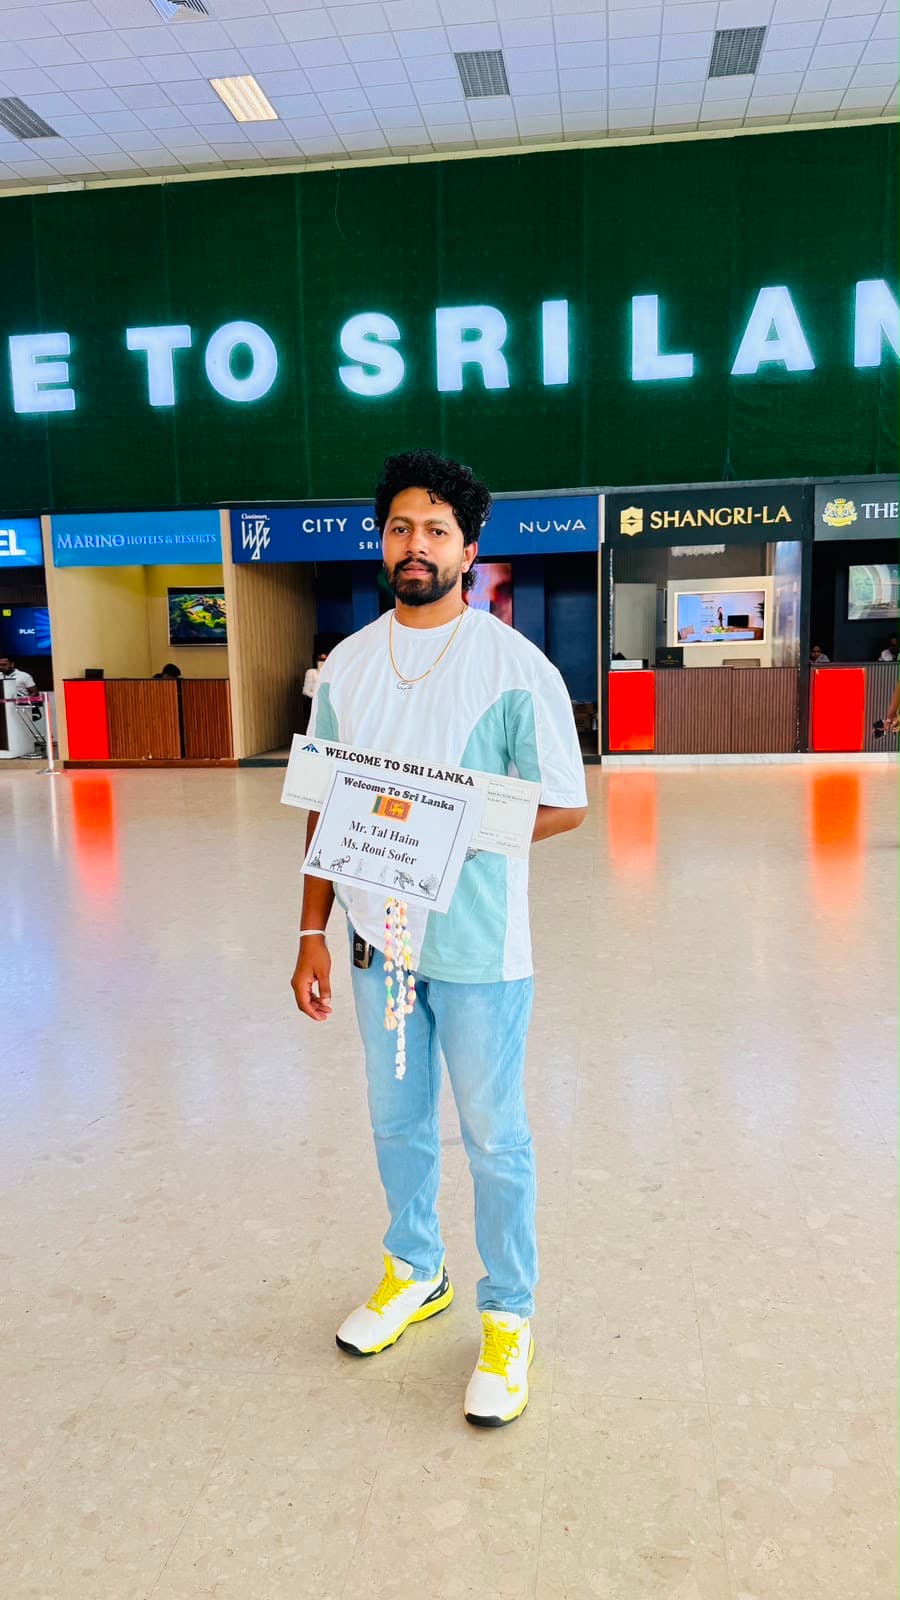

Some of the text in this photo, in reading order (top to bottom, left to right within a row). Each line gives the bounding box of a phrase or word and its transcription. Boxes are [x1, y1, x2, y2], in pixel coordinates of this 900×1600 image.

[126, 321, 279, 407] TO
[338, 299, 570, 396] SRI
[649, 504, 793, 531] SHANGRI-LA
[860, 502, 899, 519] THE
[302, 517, 348, 533] CITY
[519, 519, 586, 533] NUWA
[57, 533, 217, 549] MARINO HOTELS & RESORTS
[359, 541, 379, 550] SRI
[325, 746, 475, 787] WELCOME TO SRI LANKA
[344, 776, 455, 811] Welcome To Sri Lanka
[349, 820, 420, 847] Mr. Tal Haim
[341, 836, 417, 865] Ms. Roni Sofer
